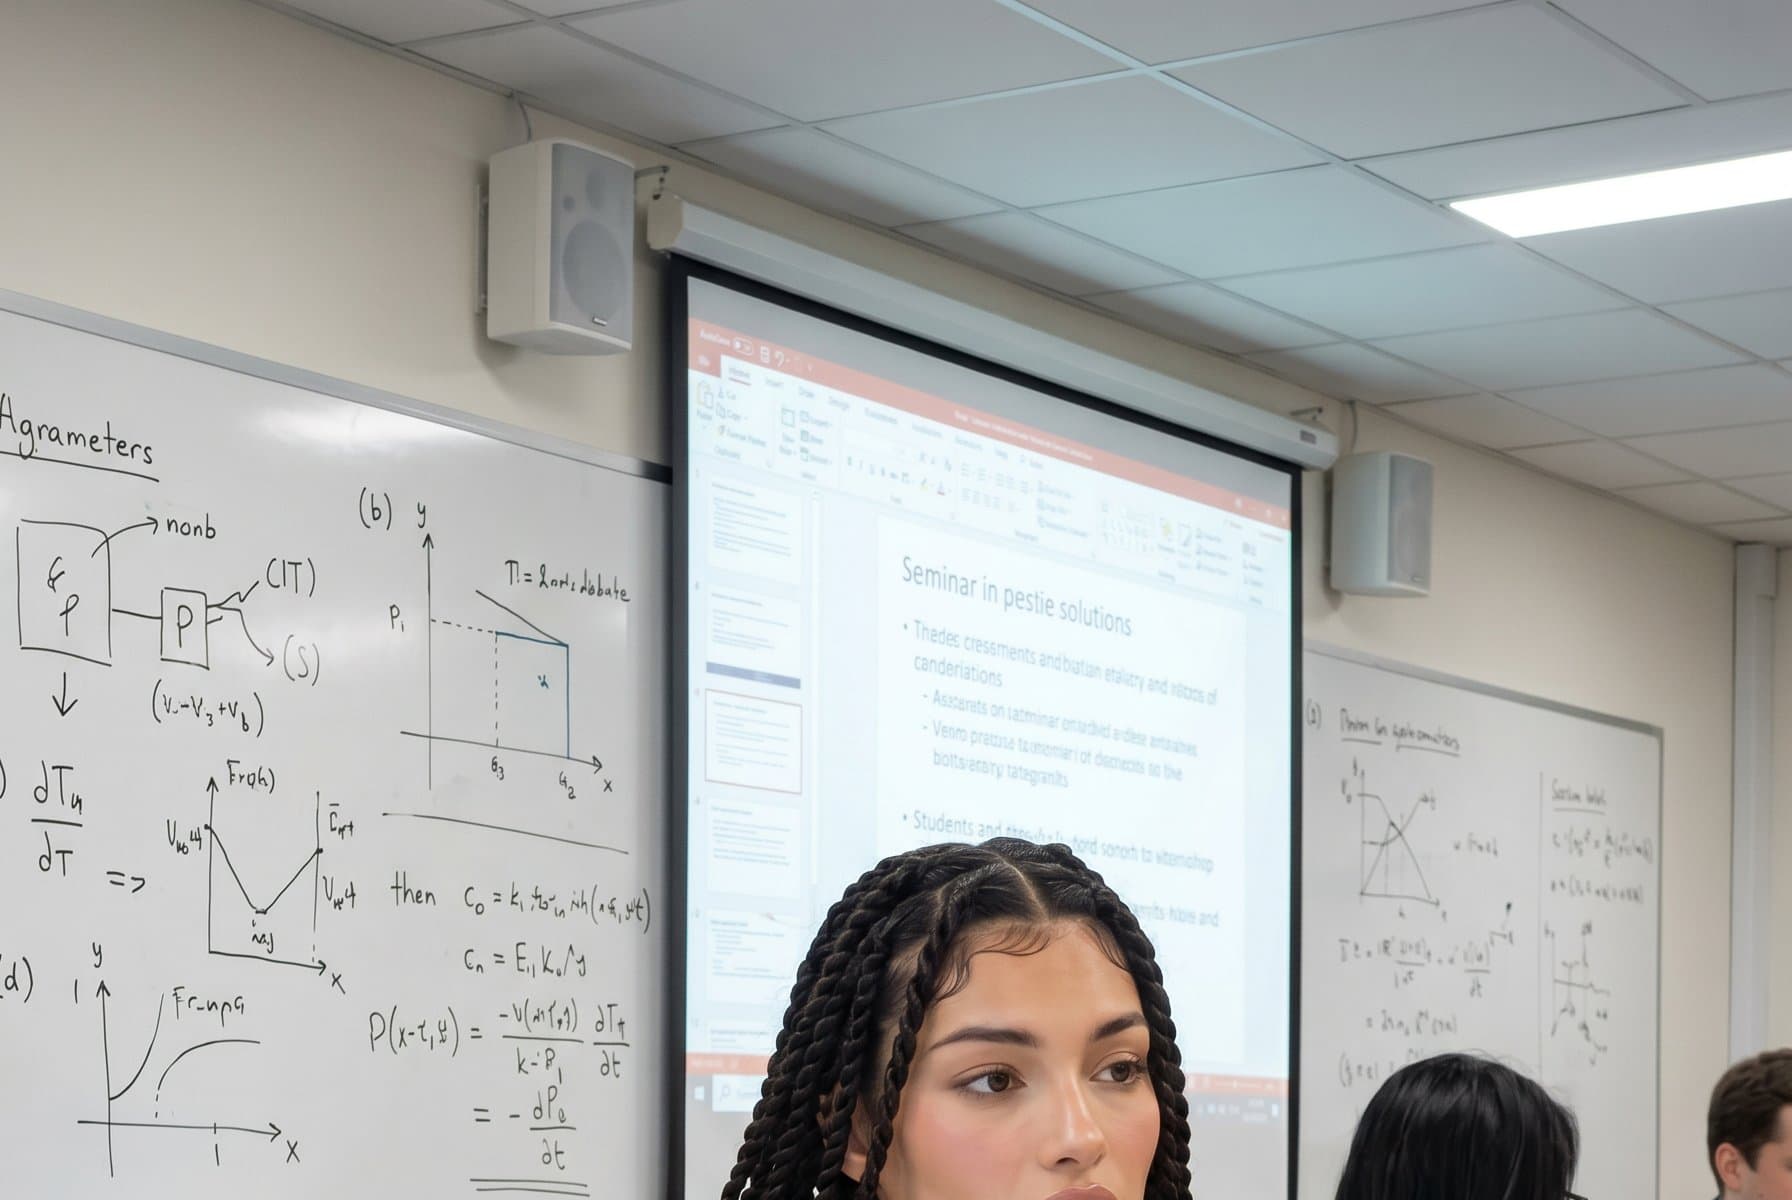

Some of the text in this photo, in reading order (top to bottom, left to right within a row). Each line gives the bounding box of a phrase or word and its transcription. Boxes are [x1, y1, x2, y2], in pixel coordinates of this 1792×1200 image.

[359, 487, 392, 531] (b)
[902, 555, 977, 599] Seminar
[982, 575, 998, 604] in
[1059, 596, 1133, 638] solutions
[913, 809, 975, 838] Students
[391, 870, 436, 906] then
